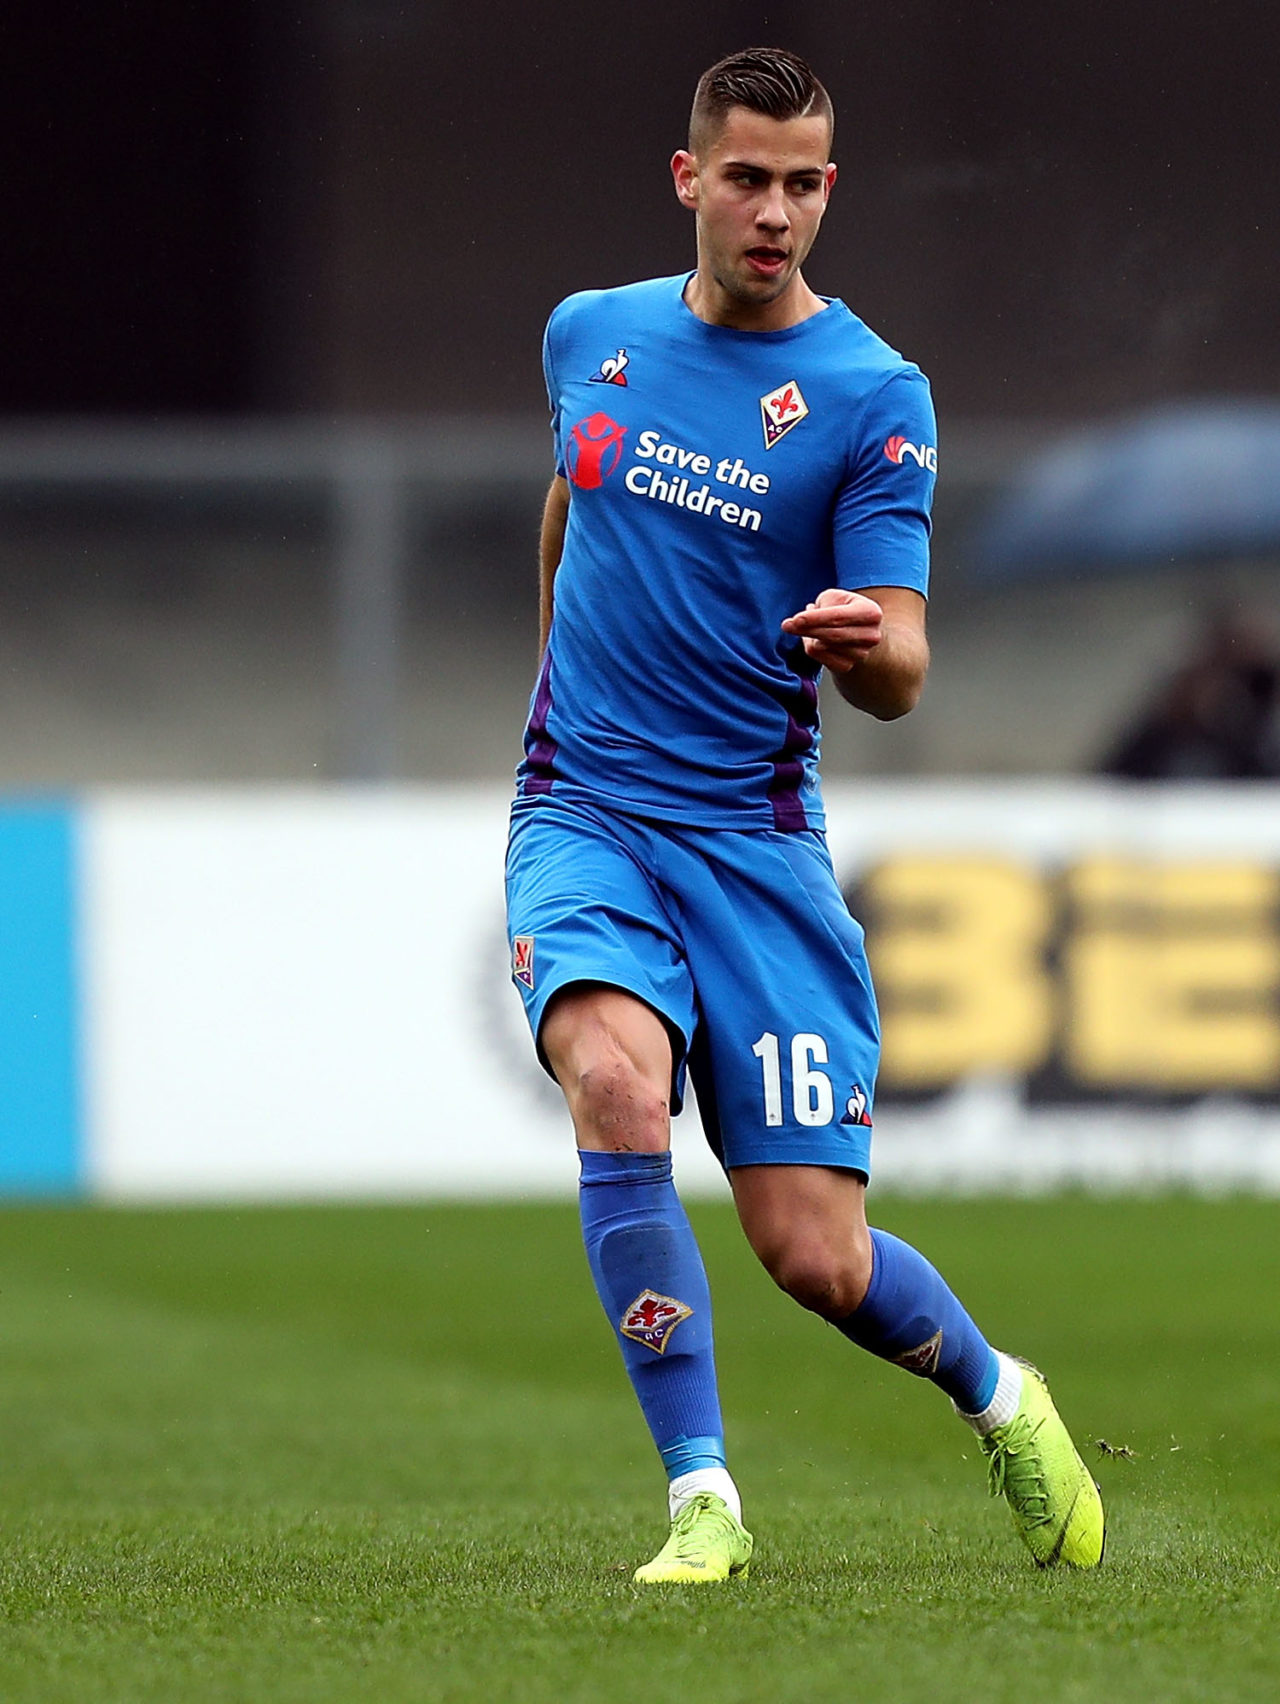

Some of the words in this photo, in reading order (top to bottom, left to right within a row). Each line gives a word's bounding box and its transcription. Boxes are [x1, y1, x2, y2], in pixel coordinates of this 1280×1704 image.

[634, 430, 712, 475] Save
[715, 458, 770, 495] the
[624, 465, 763, 532] Children
[751, 1031, 834, 1127] 16
